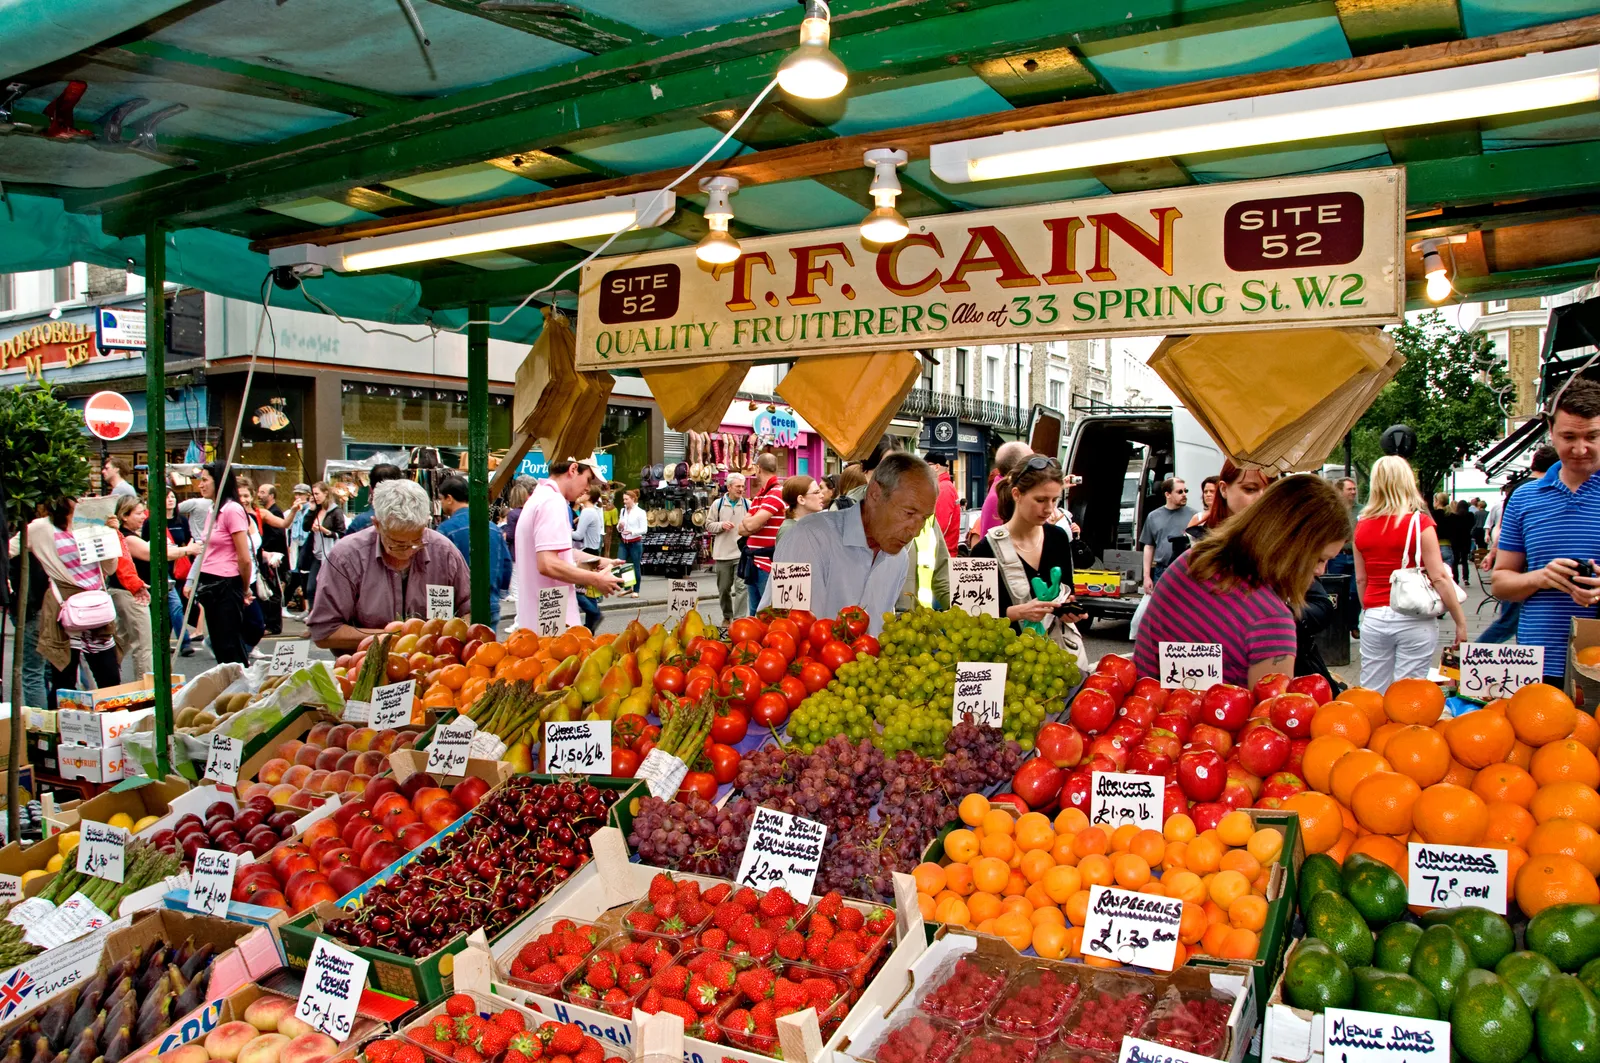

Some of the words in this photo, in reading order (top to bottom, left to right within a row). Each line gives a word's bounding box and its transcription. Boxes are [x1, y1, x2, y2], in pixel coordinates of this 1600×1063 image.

[1239, 203, 1342, 230] SITE
[875, 206, 1183, 297] CAIN
[1261, 231, 1322, 259] 52
[611, 273, 668, 294] SITE
[622, 295, 656, 315] 52
[596, 321, 718, 359] QUALITY
[732, 302, 949, 346] FRUITERERS
[951, 302, 983, 327] Also
[986, 303, 1008, 327] at
[1008, 294, 1059, 326] 33
[1072, 281, 1227, 321] SPRING
[1240, 278, 1290, 311] St.
[1293, 273, 1365, 309] W.2
[771, 415, 796, 428] Green
[773, 564, 786, 576] VINE
[1167, 643, 1187, 653] PINK
[1191, 644, 1221, 654] LADIES
[1466, 644, 1494, 659] LARGE
[955, 668, 992, 679] SEEDLESS
[1166, 661, 1204, 684] £1.00
[1208, 664, 1219, 679] lb.
[1465, 668, 1483, 690] 3
[959, 683, 982, 692] GRAPE
[992, 700, 1001, 720] lb
[213, 734, 231, 746] PLUMS
[547, 723, 590, 737] CHERRIES
[548, 743, 583, 770] £1.50
[594, 742, 606, 761] lb.
[1099, 775, 1152, 792] APRICOTS
[1093, 799, 1135, 824] £1.00
[1139, 802, 1154, 820] lb.
[755, 810, 784, 827] EXTRA
[789, 816, 822, 835] SPECIAL
[754, 832, 820, 856] STRAWBERRIES
[1418, 848, 1496, 868] ADVOCADOS
[742, 855, 783, 886] £2.00
[1464, 885, 1490, 899] EACH
[1097, 889, 1183, 919] RASPBERRIES
[1090, 919, 1149, 953] £1.30
[35, 969, 82, 999] Finest
[302, 995, 314, 1016] 5
[319, 1002, 350, 1034] £1.50
[1391, 1025, 1434, 1045] DATES
